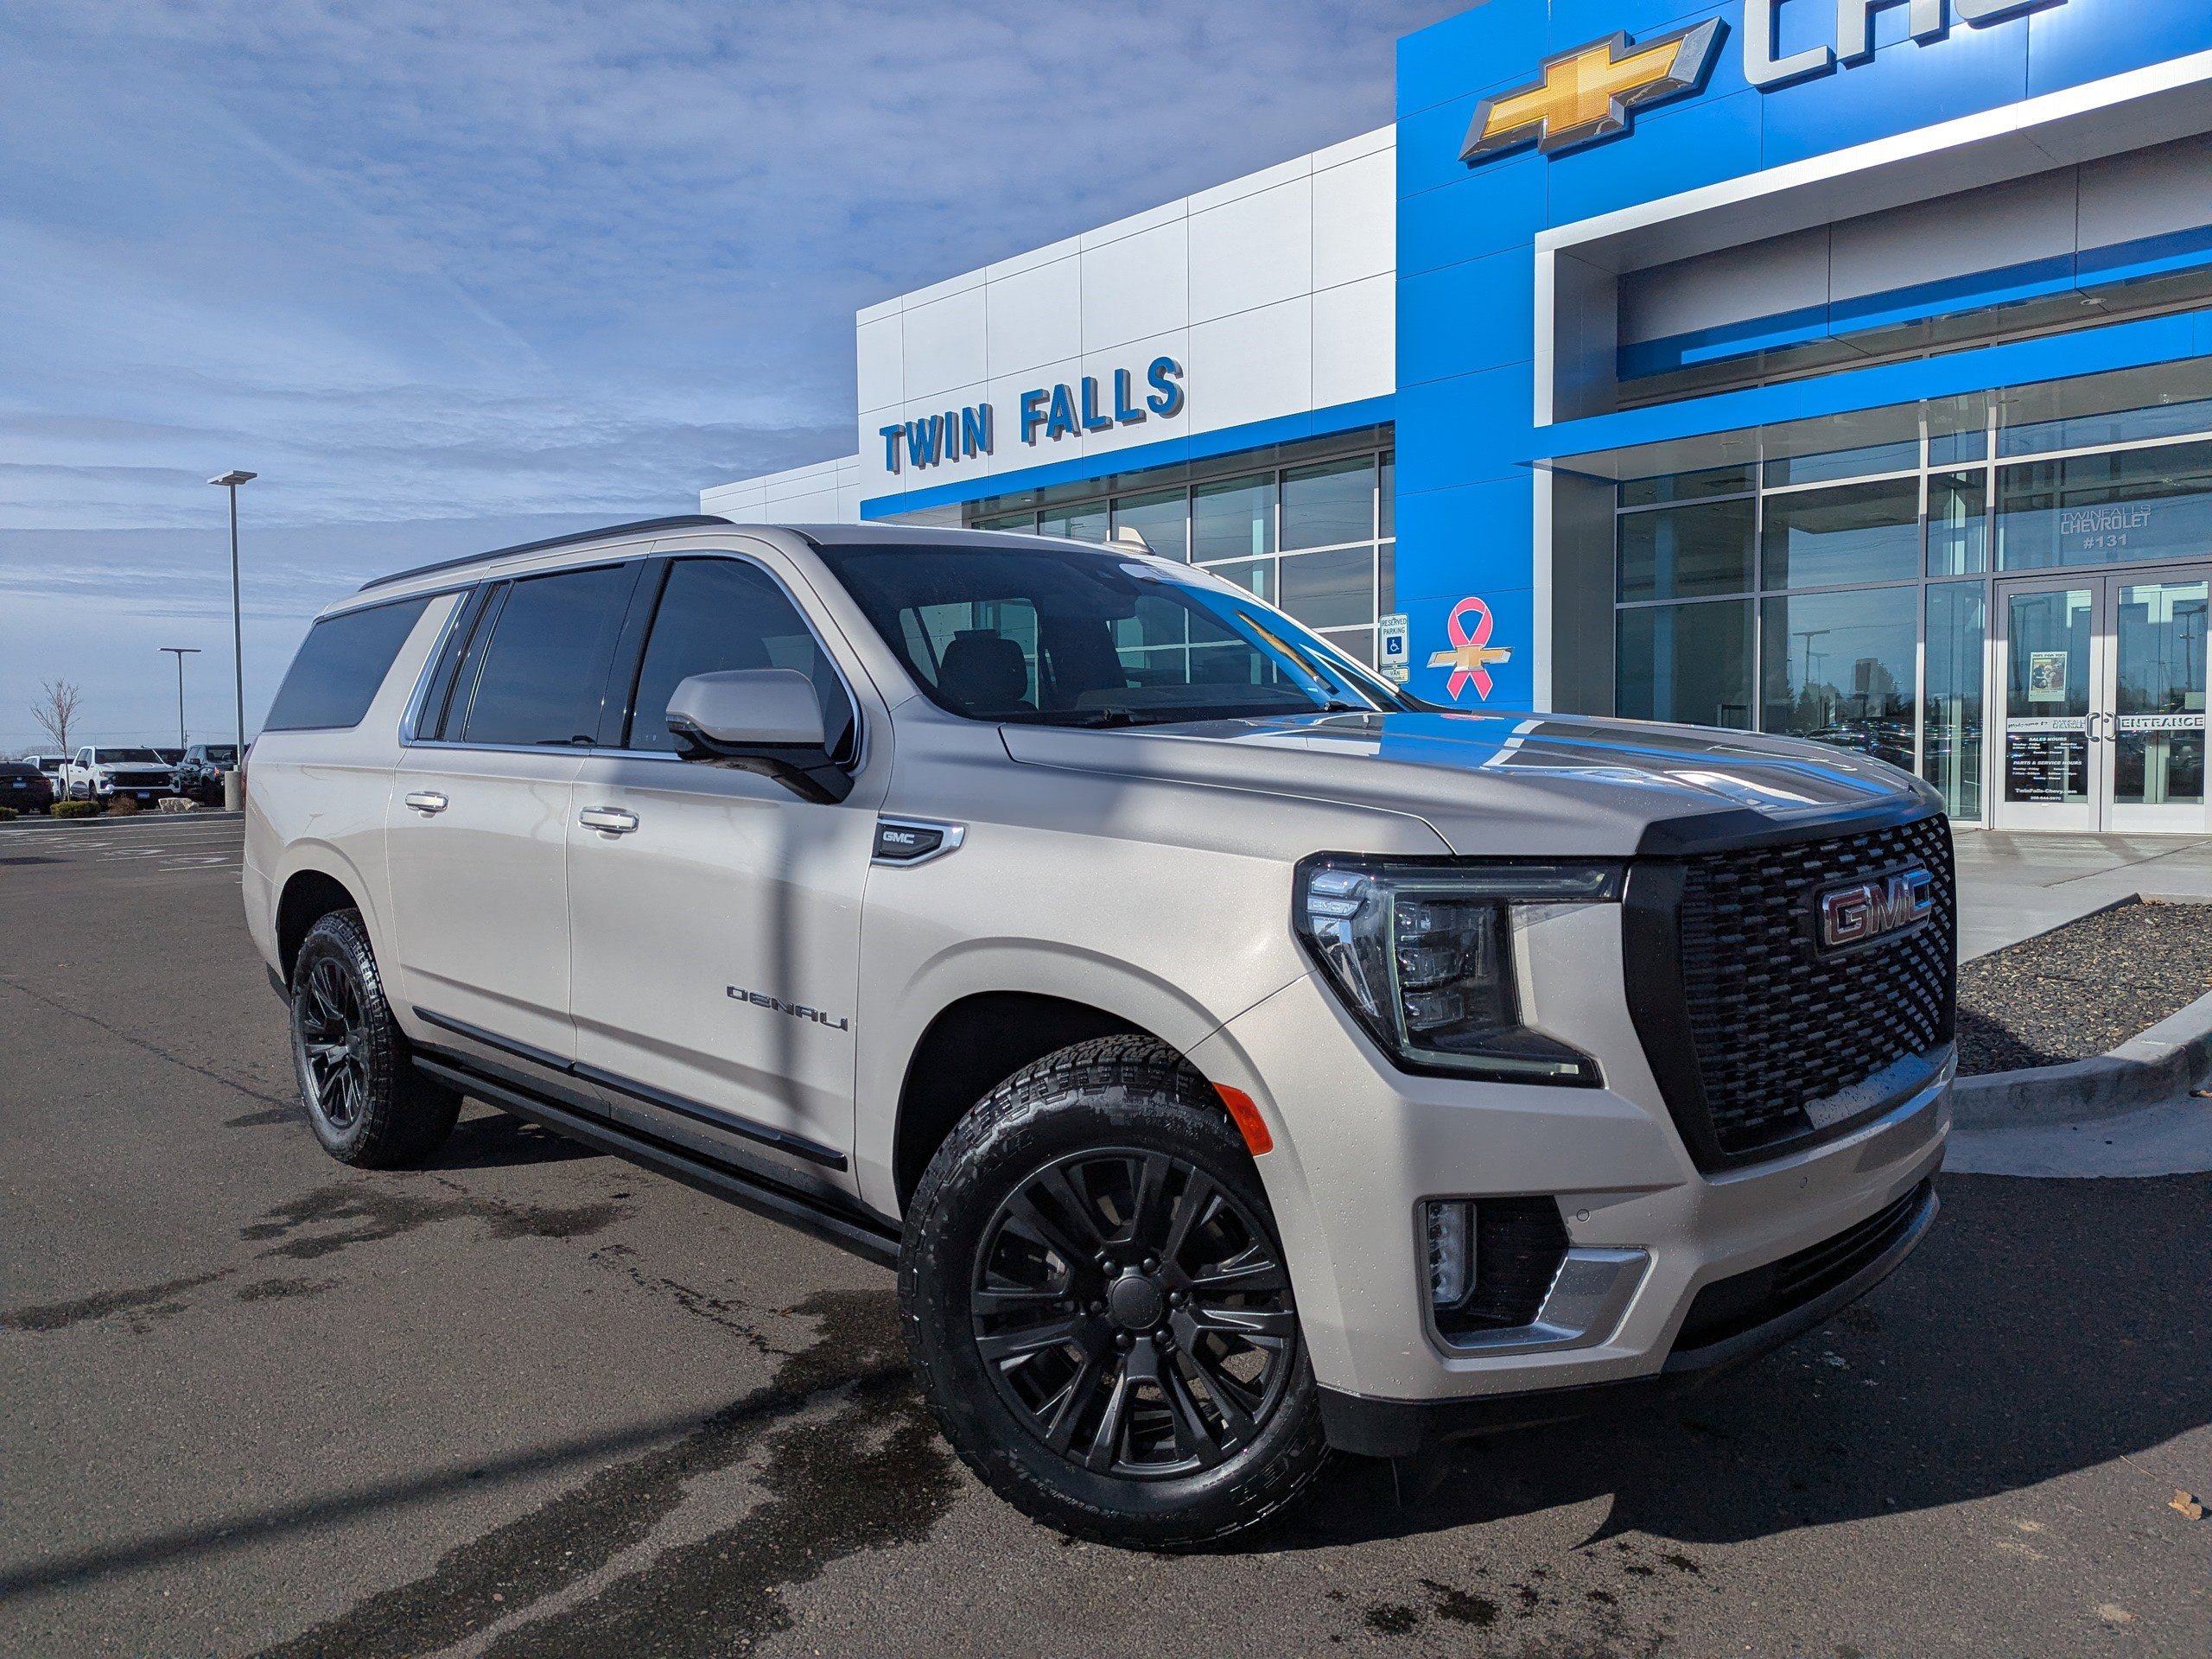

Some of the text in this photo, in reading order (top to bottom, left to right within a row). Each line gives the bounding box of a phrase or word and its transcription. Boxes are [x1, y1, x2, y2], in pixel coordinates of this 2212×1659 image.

[880, 356, 1185, 475] TWIN FALLS
[2061, 512, 2152, 535] CHEVROLET
[2083, 533, 2126, 549] #131
[1382, 618, 1407, 626] RESERVED
[2121, 717, 2204, 728] ENTRANCE
[882, 830, 915, 844] GMC
[1822, 868, 1932, 945] GMC
[726, 984, 849, 1032] DENALI
